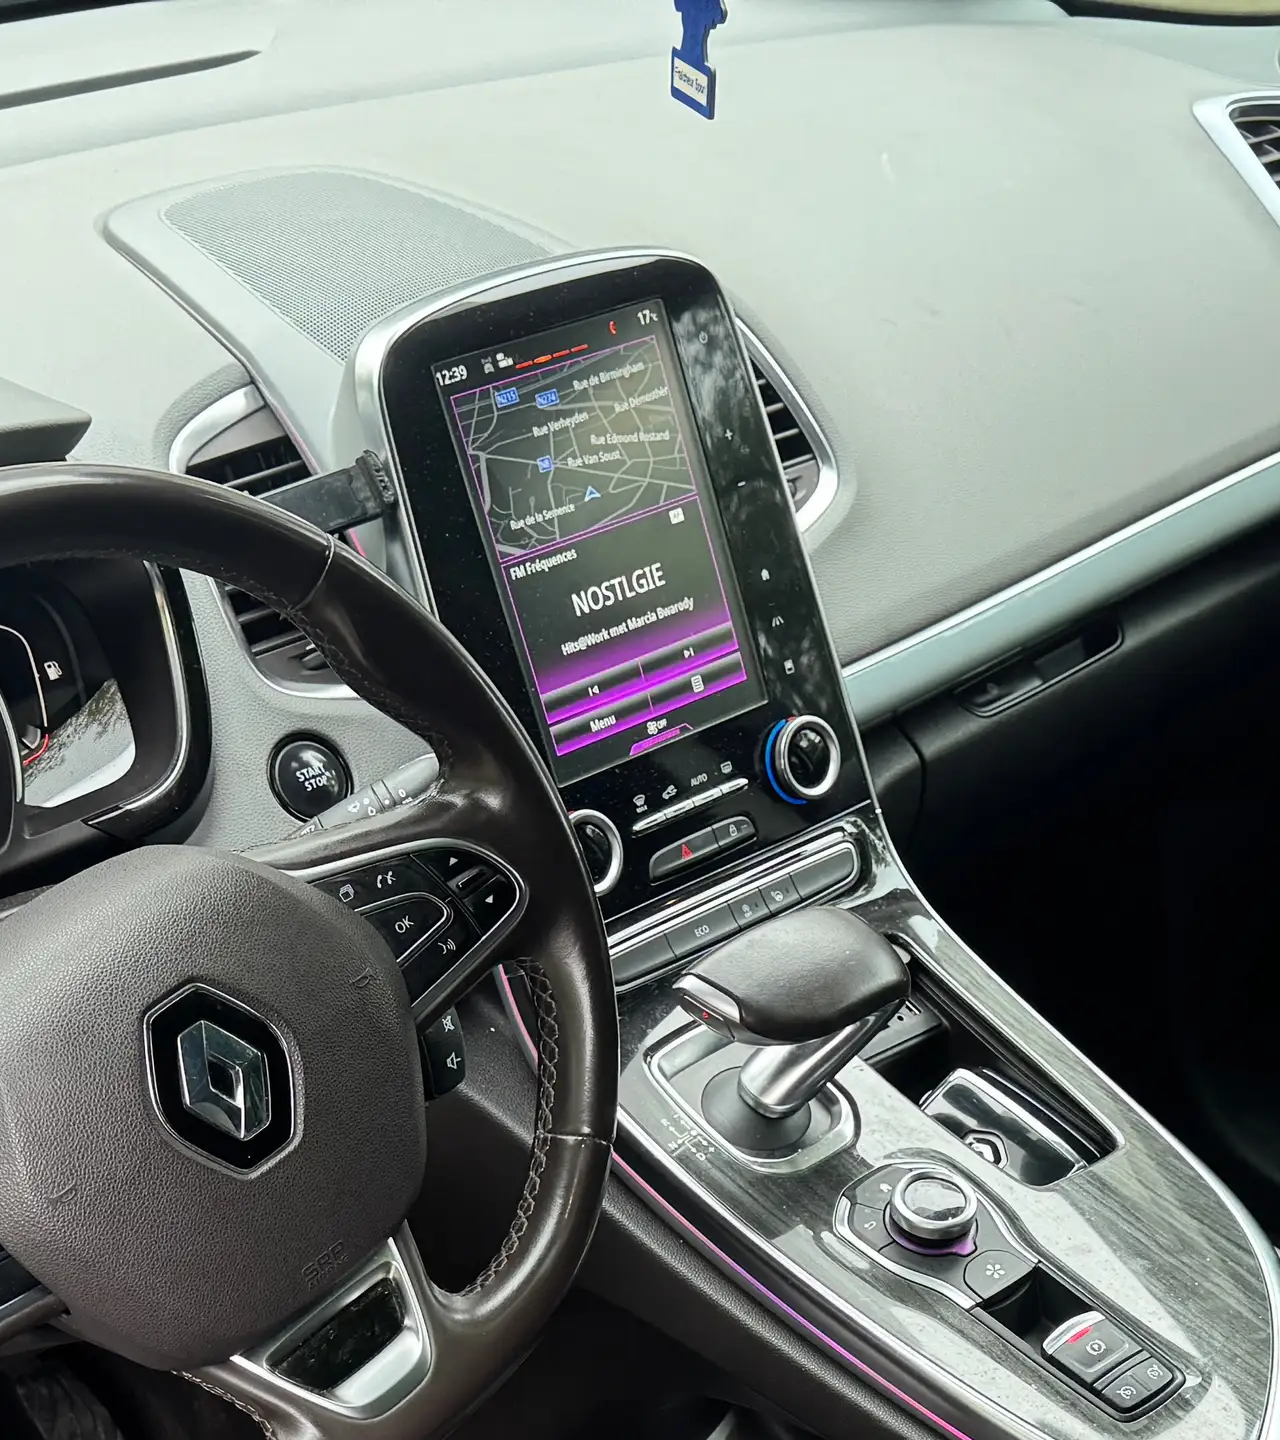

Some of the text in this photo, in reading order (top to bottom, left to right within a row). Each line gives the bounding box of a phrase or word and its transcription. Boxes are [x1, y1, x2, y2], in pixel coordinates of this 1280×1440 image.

[435, 364, 467, 386] 12:39
[573, 361, 645, 391] Rue de Birmingham
[614, 402, 629, 413] Rue
[532, 411, 589, 438] Rue Verheyden
[590, 434, 606, 445] Rue
[606, 431, 638, 444] Edmond
[567, 457, 583, 469] Rue
[582, 454, 599, 465] Van
[509, 503, 576, 531] Rue de la Semence
[509, 548, 578, 581] FM Fréquences
[571, 562, 667, 617] NOSTLGIE
[561, 628, 610, 656] Hits@Work
[609, 621, 628, 638] met
[627, 611, 658, 630] Marcia
[589, 714, 617, 733] Menu
[295, 762, 326, 782] START
[690, 772, 708, 787] AUTO
[304, 775, 329, 791] STOP
[394, 915, 414, 934] OK
[694, 924, 710, 938] ECO
